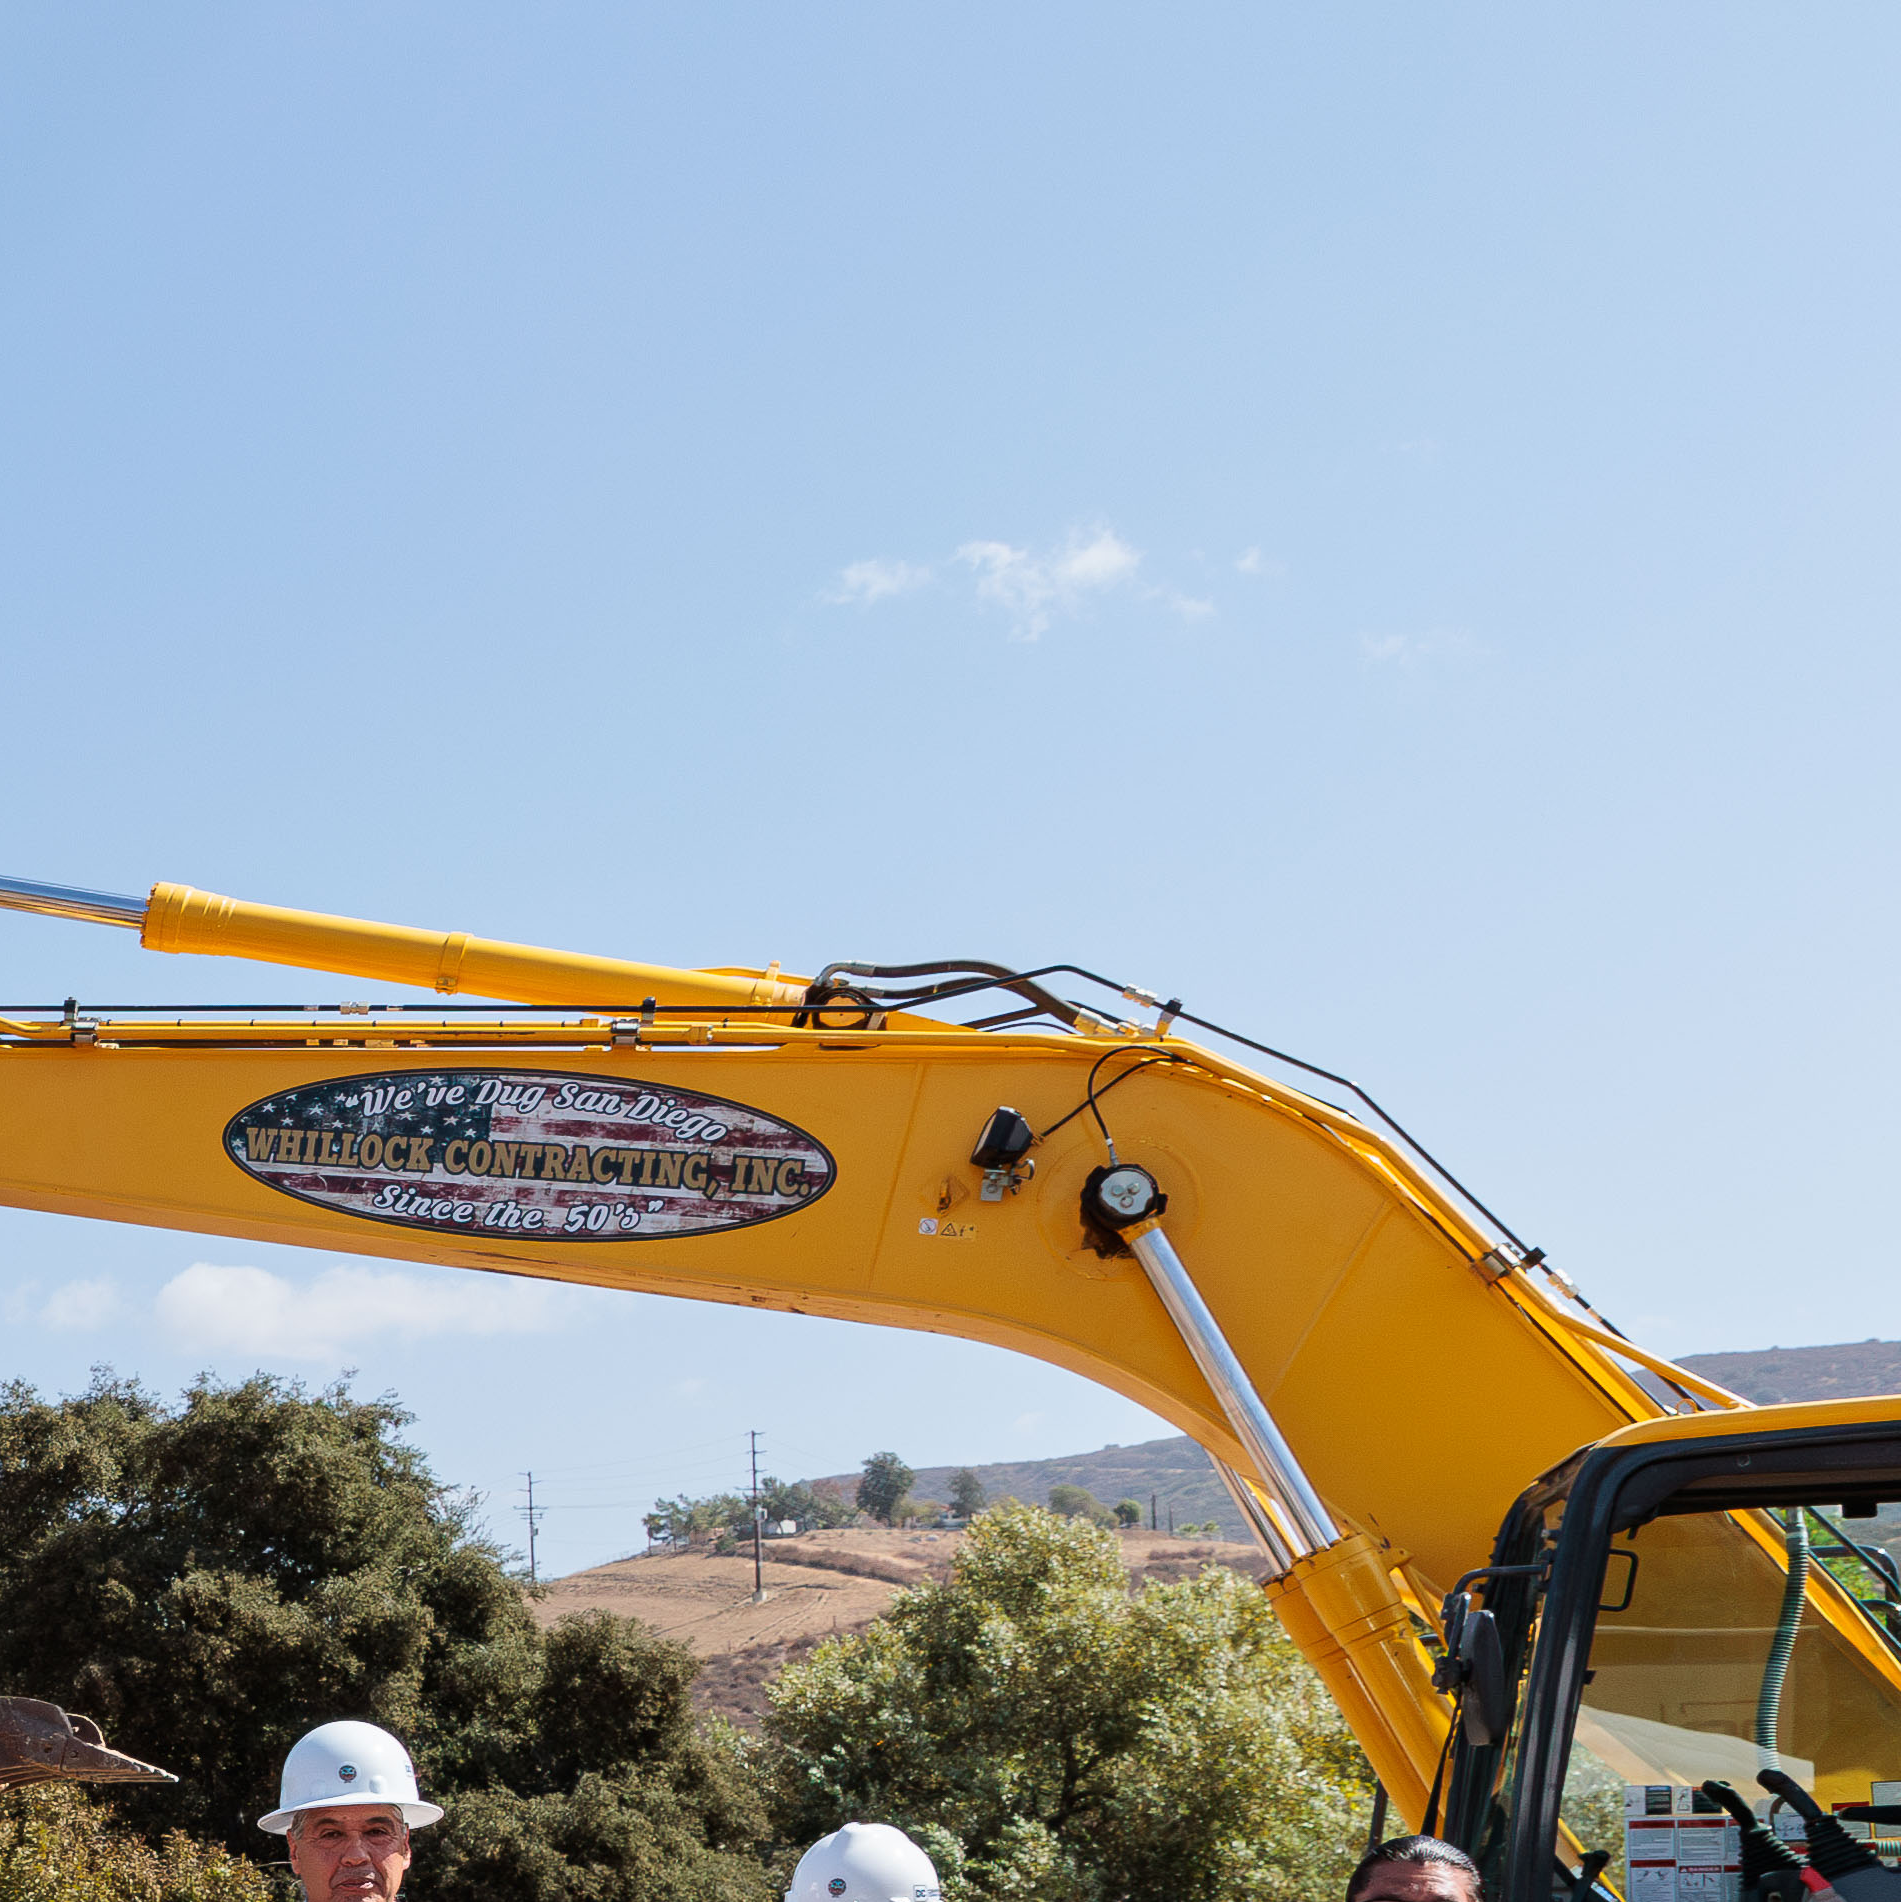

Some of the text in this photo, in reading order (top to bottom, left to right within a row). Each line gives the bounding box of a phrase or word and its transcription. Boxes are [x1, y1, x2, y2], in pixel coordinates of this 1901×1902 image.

[477, 1079, 545, 1112] Dug
[553, 1082, 621, 1115] San
[627, 1094, 727, 1141] Diego
[247, 1127, 812, 1198] WHILLOCK CONTRACTING, INC.
[374, 1185, 475, 1223] Since
[485, 1202, 543, 1229] the
